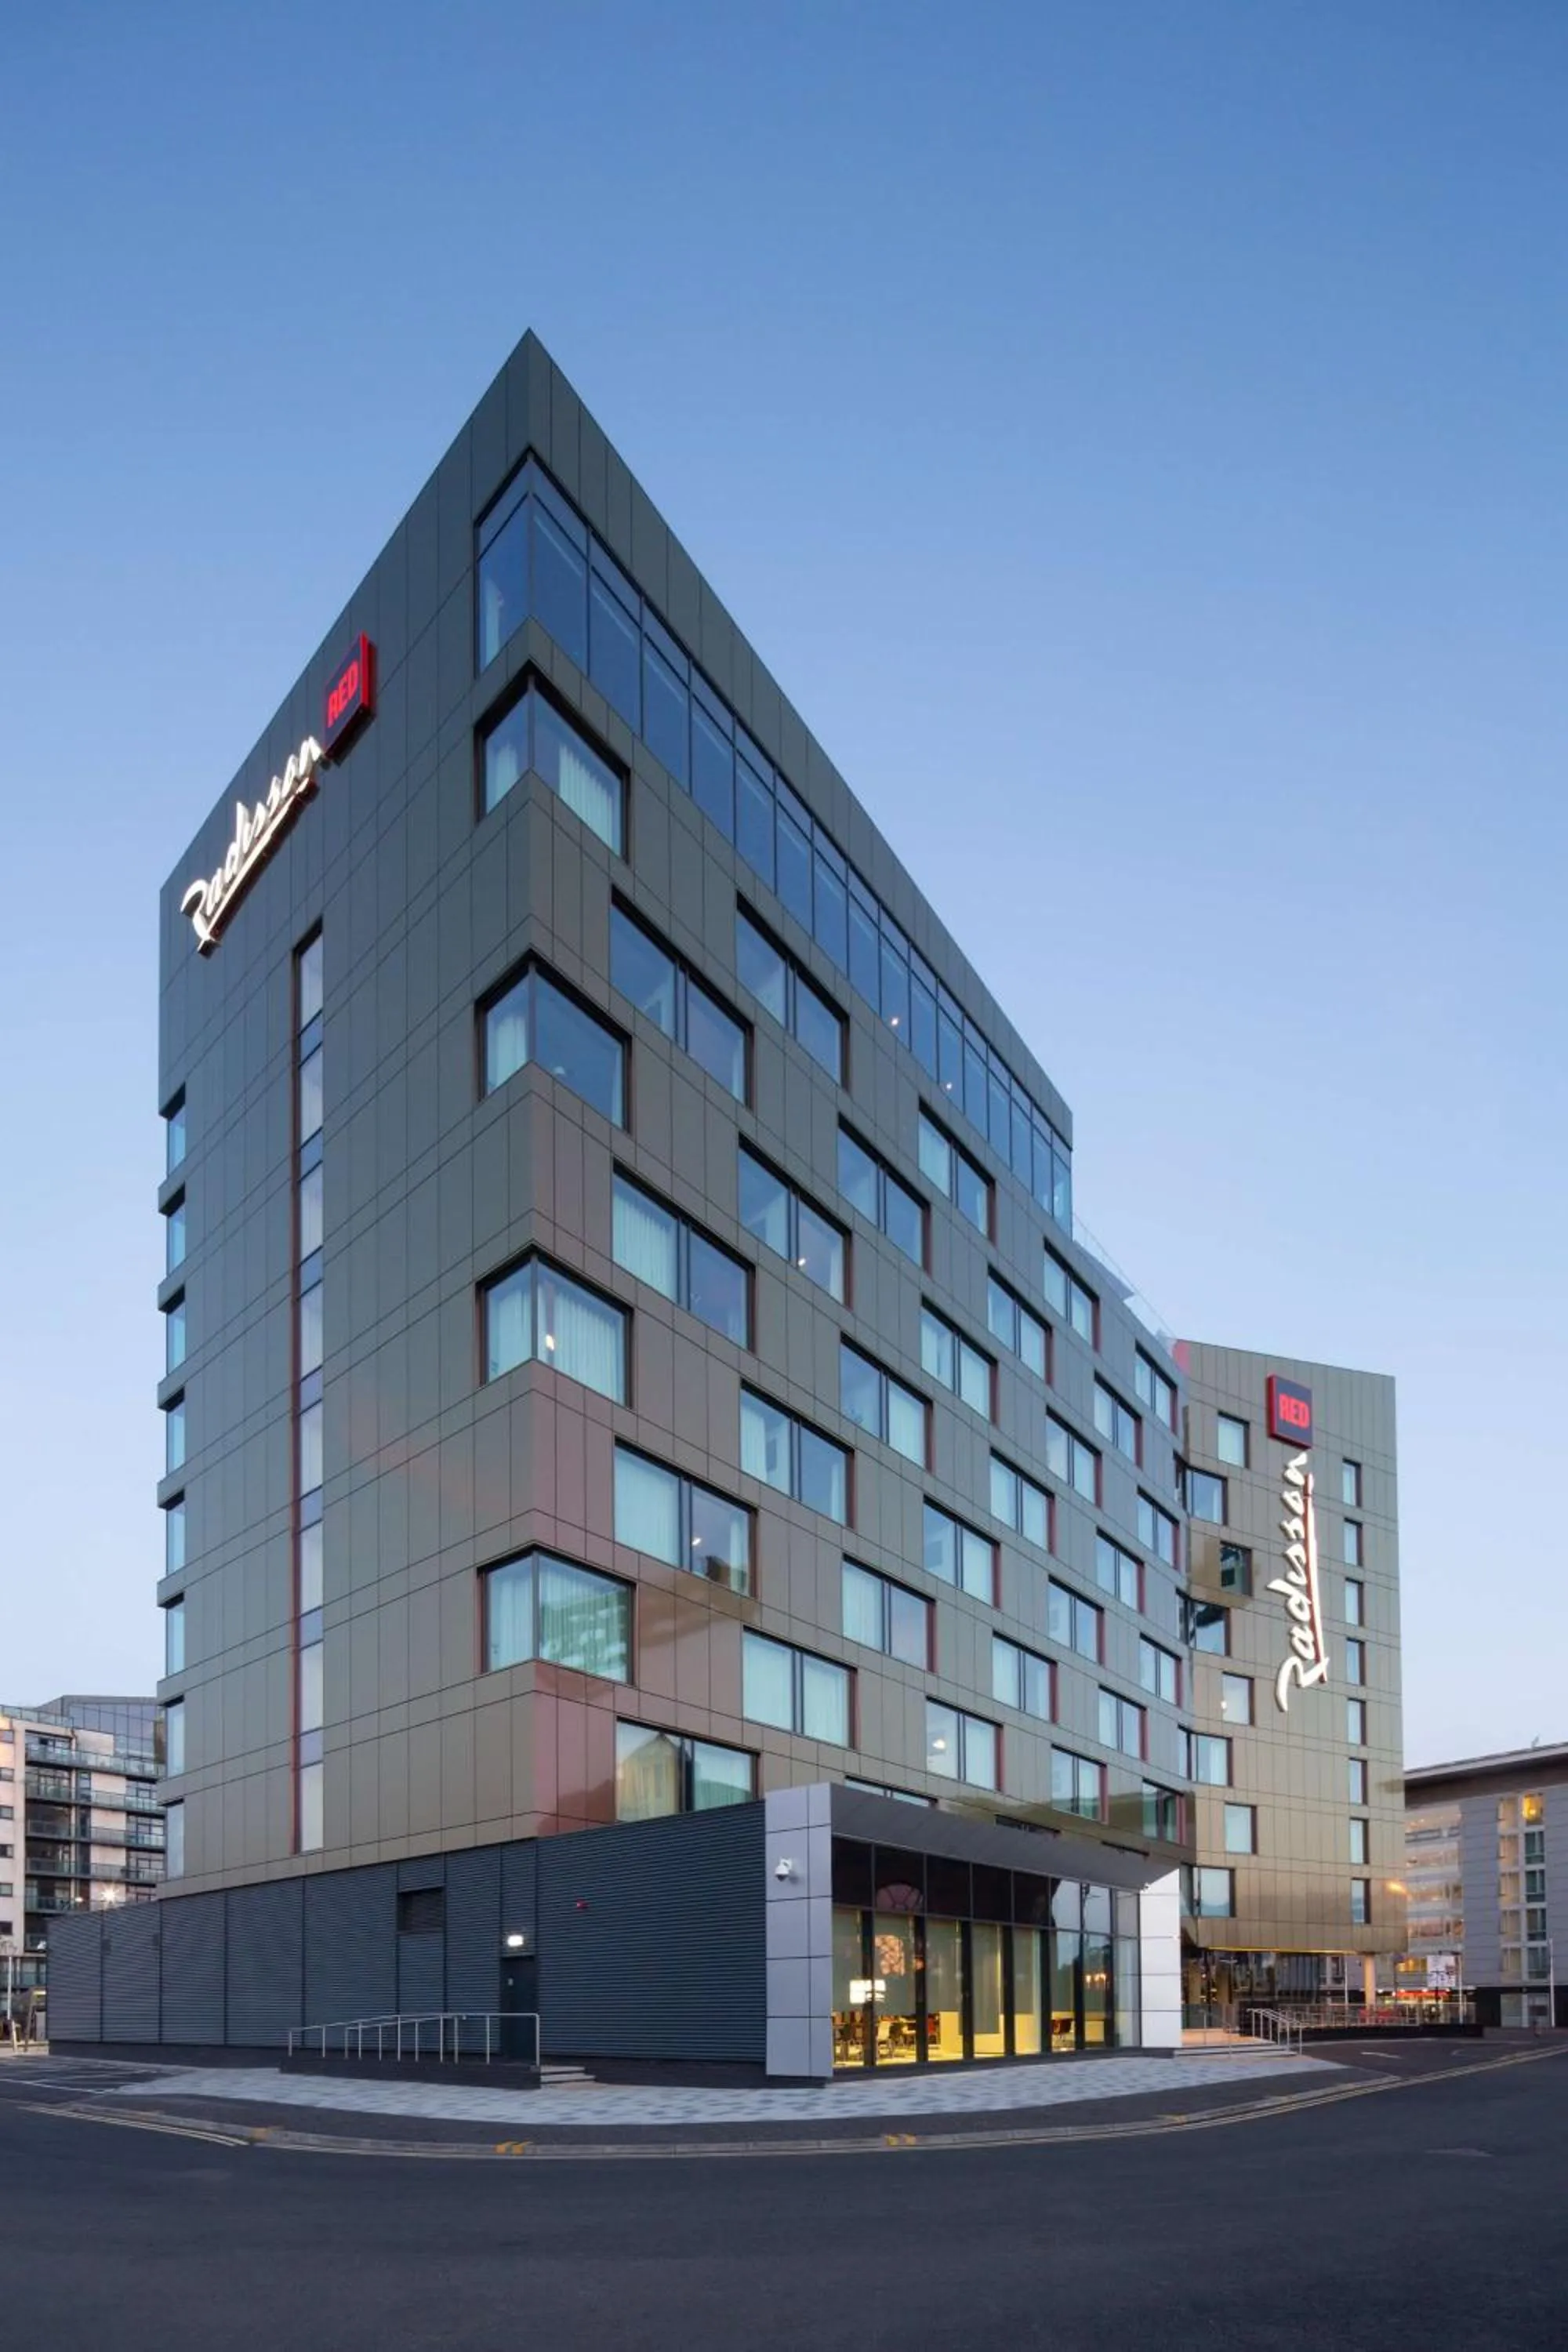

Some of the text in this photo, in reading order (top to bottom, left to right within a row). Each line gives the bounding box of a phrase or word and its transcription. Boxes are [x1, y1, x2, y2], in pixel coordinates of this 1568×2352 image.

[180, 660, 358, 952] Radisson RED
[1266, 1392, 1329, 1712] Radisson RED
